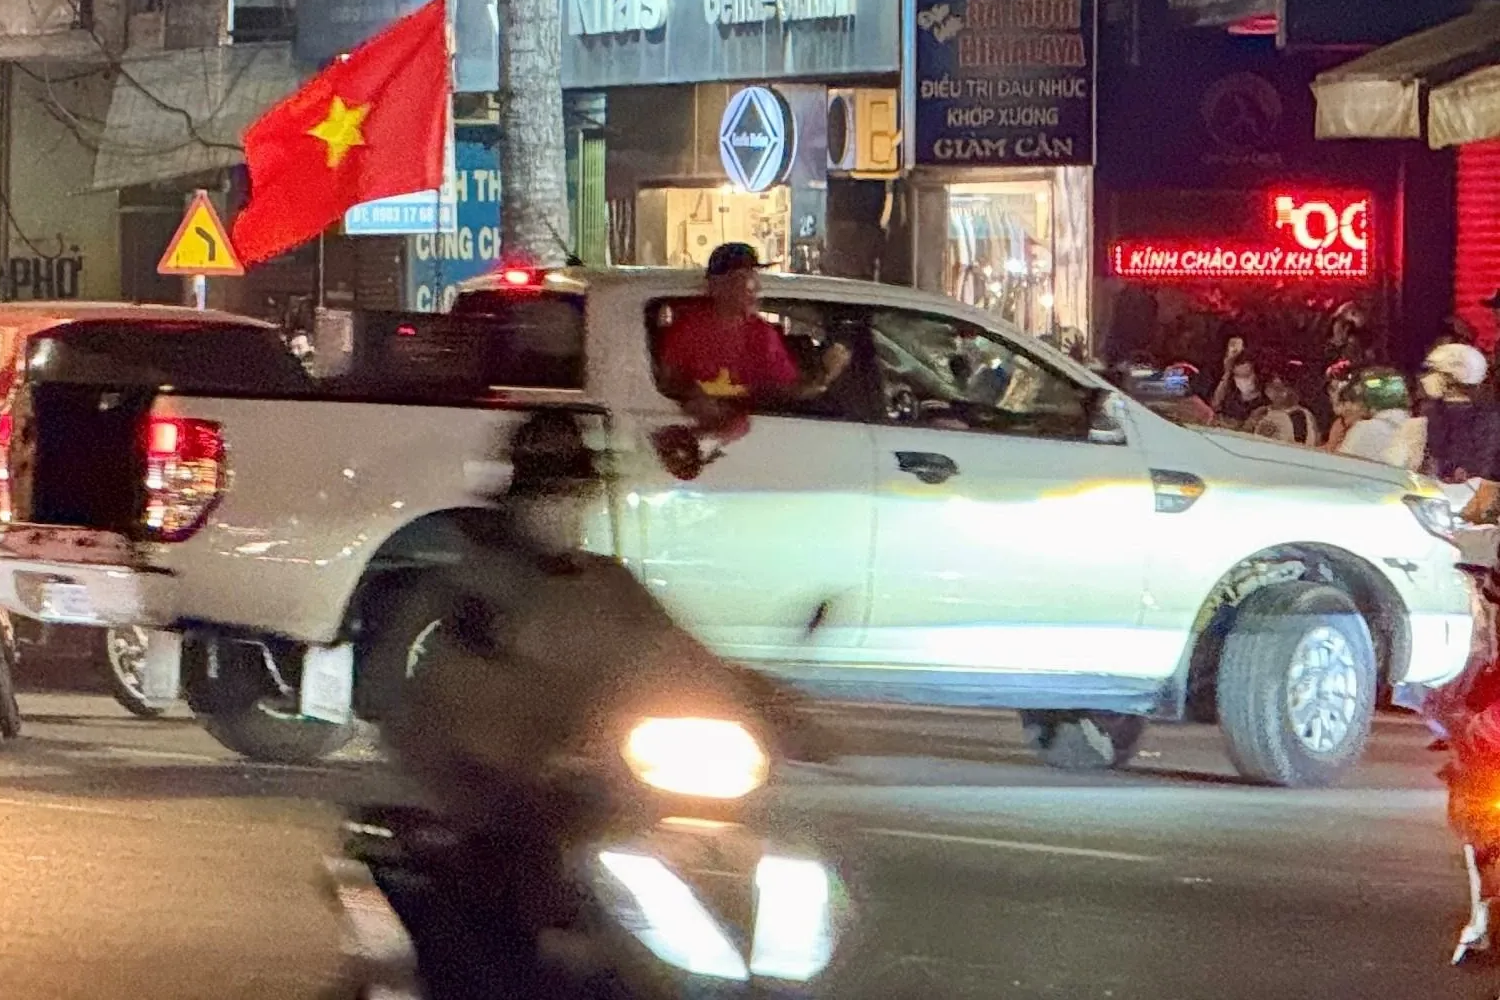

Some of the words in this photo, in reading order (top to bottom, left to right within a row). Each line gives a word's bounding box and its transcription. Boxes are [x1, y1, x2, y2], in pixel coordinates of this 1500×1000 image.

[966, 80, 993, 101] TRỊ
[998, 80, 1036, 98] ĐAU
[1130, 246, 1178, 269] KÍNH
[1181, 246, 1237, 270] CHÀO
[1239, 246, 1281, 271] QUÝ
[1285, 248, 1353, 271] KHÁCH
